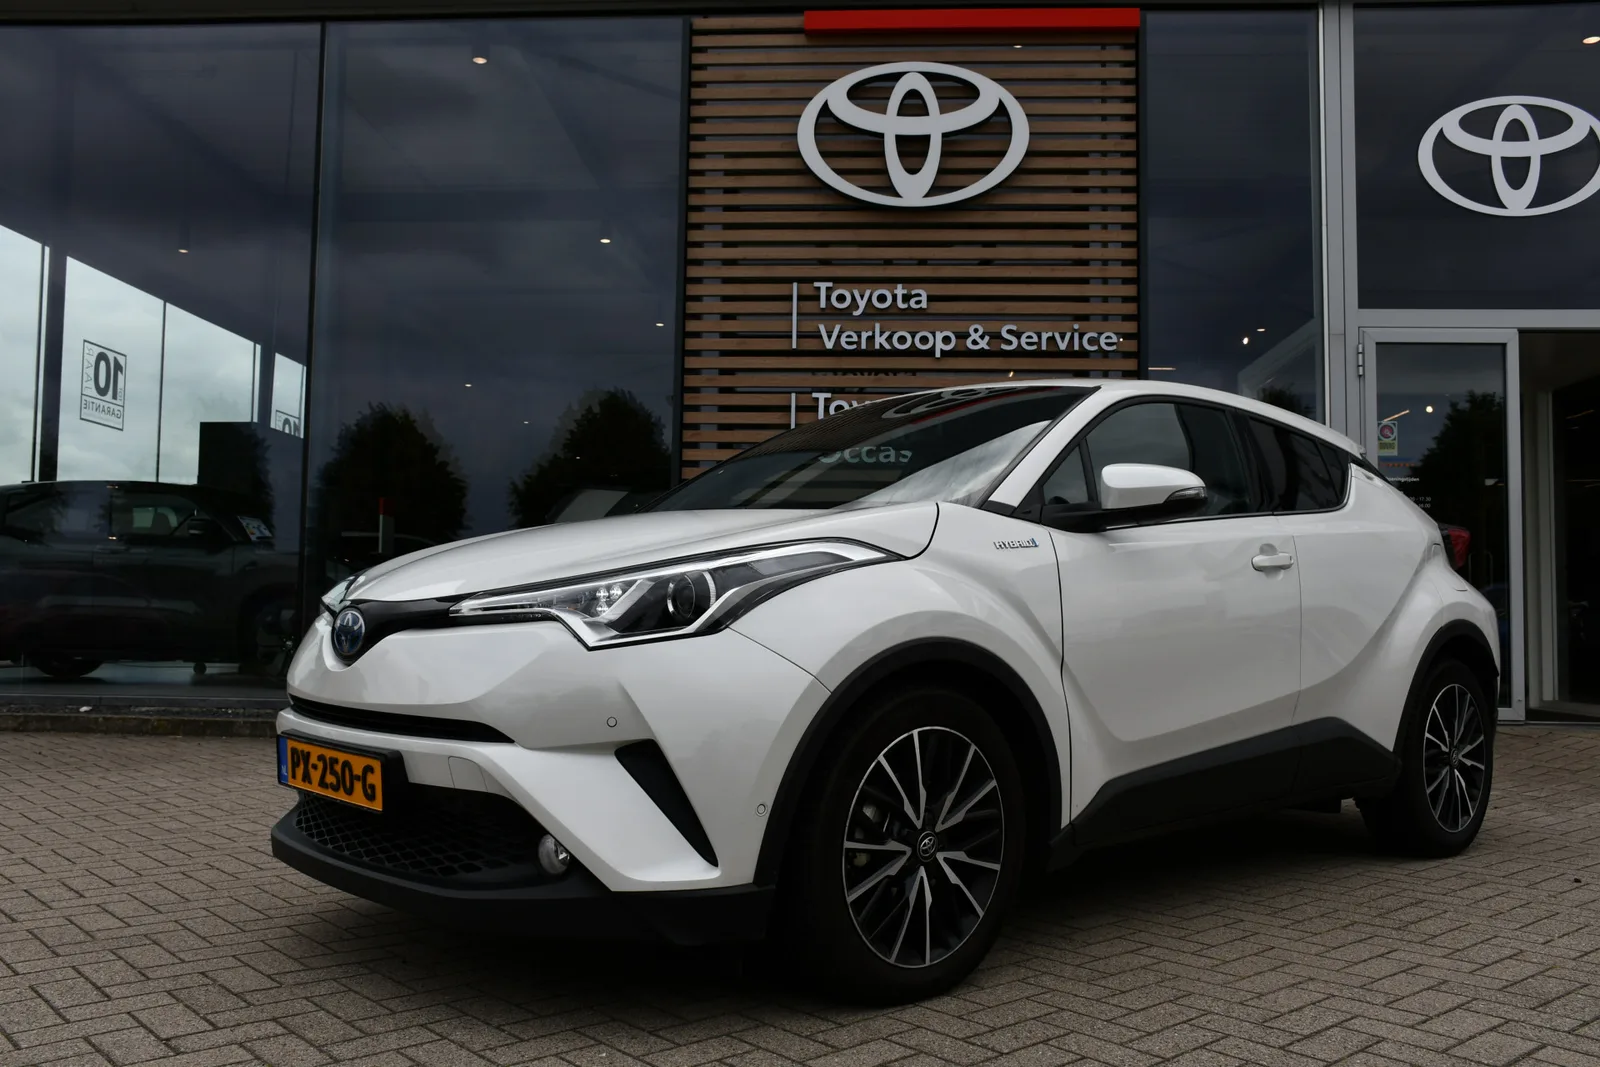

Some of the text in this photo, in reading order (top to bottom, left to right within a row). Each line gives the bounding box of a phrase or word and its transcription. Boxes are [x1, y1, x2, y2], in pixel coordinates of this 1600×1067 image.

[813, 281, 928, 316] Toyota
[818, 323, 1118, 358] Verkoop & Service
[290, 746, 376, 802] PX-250-G
